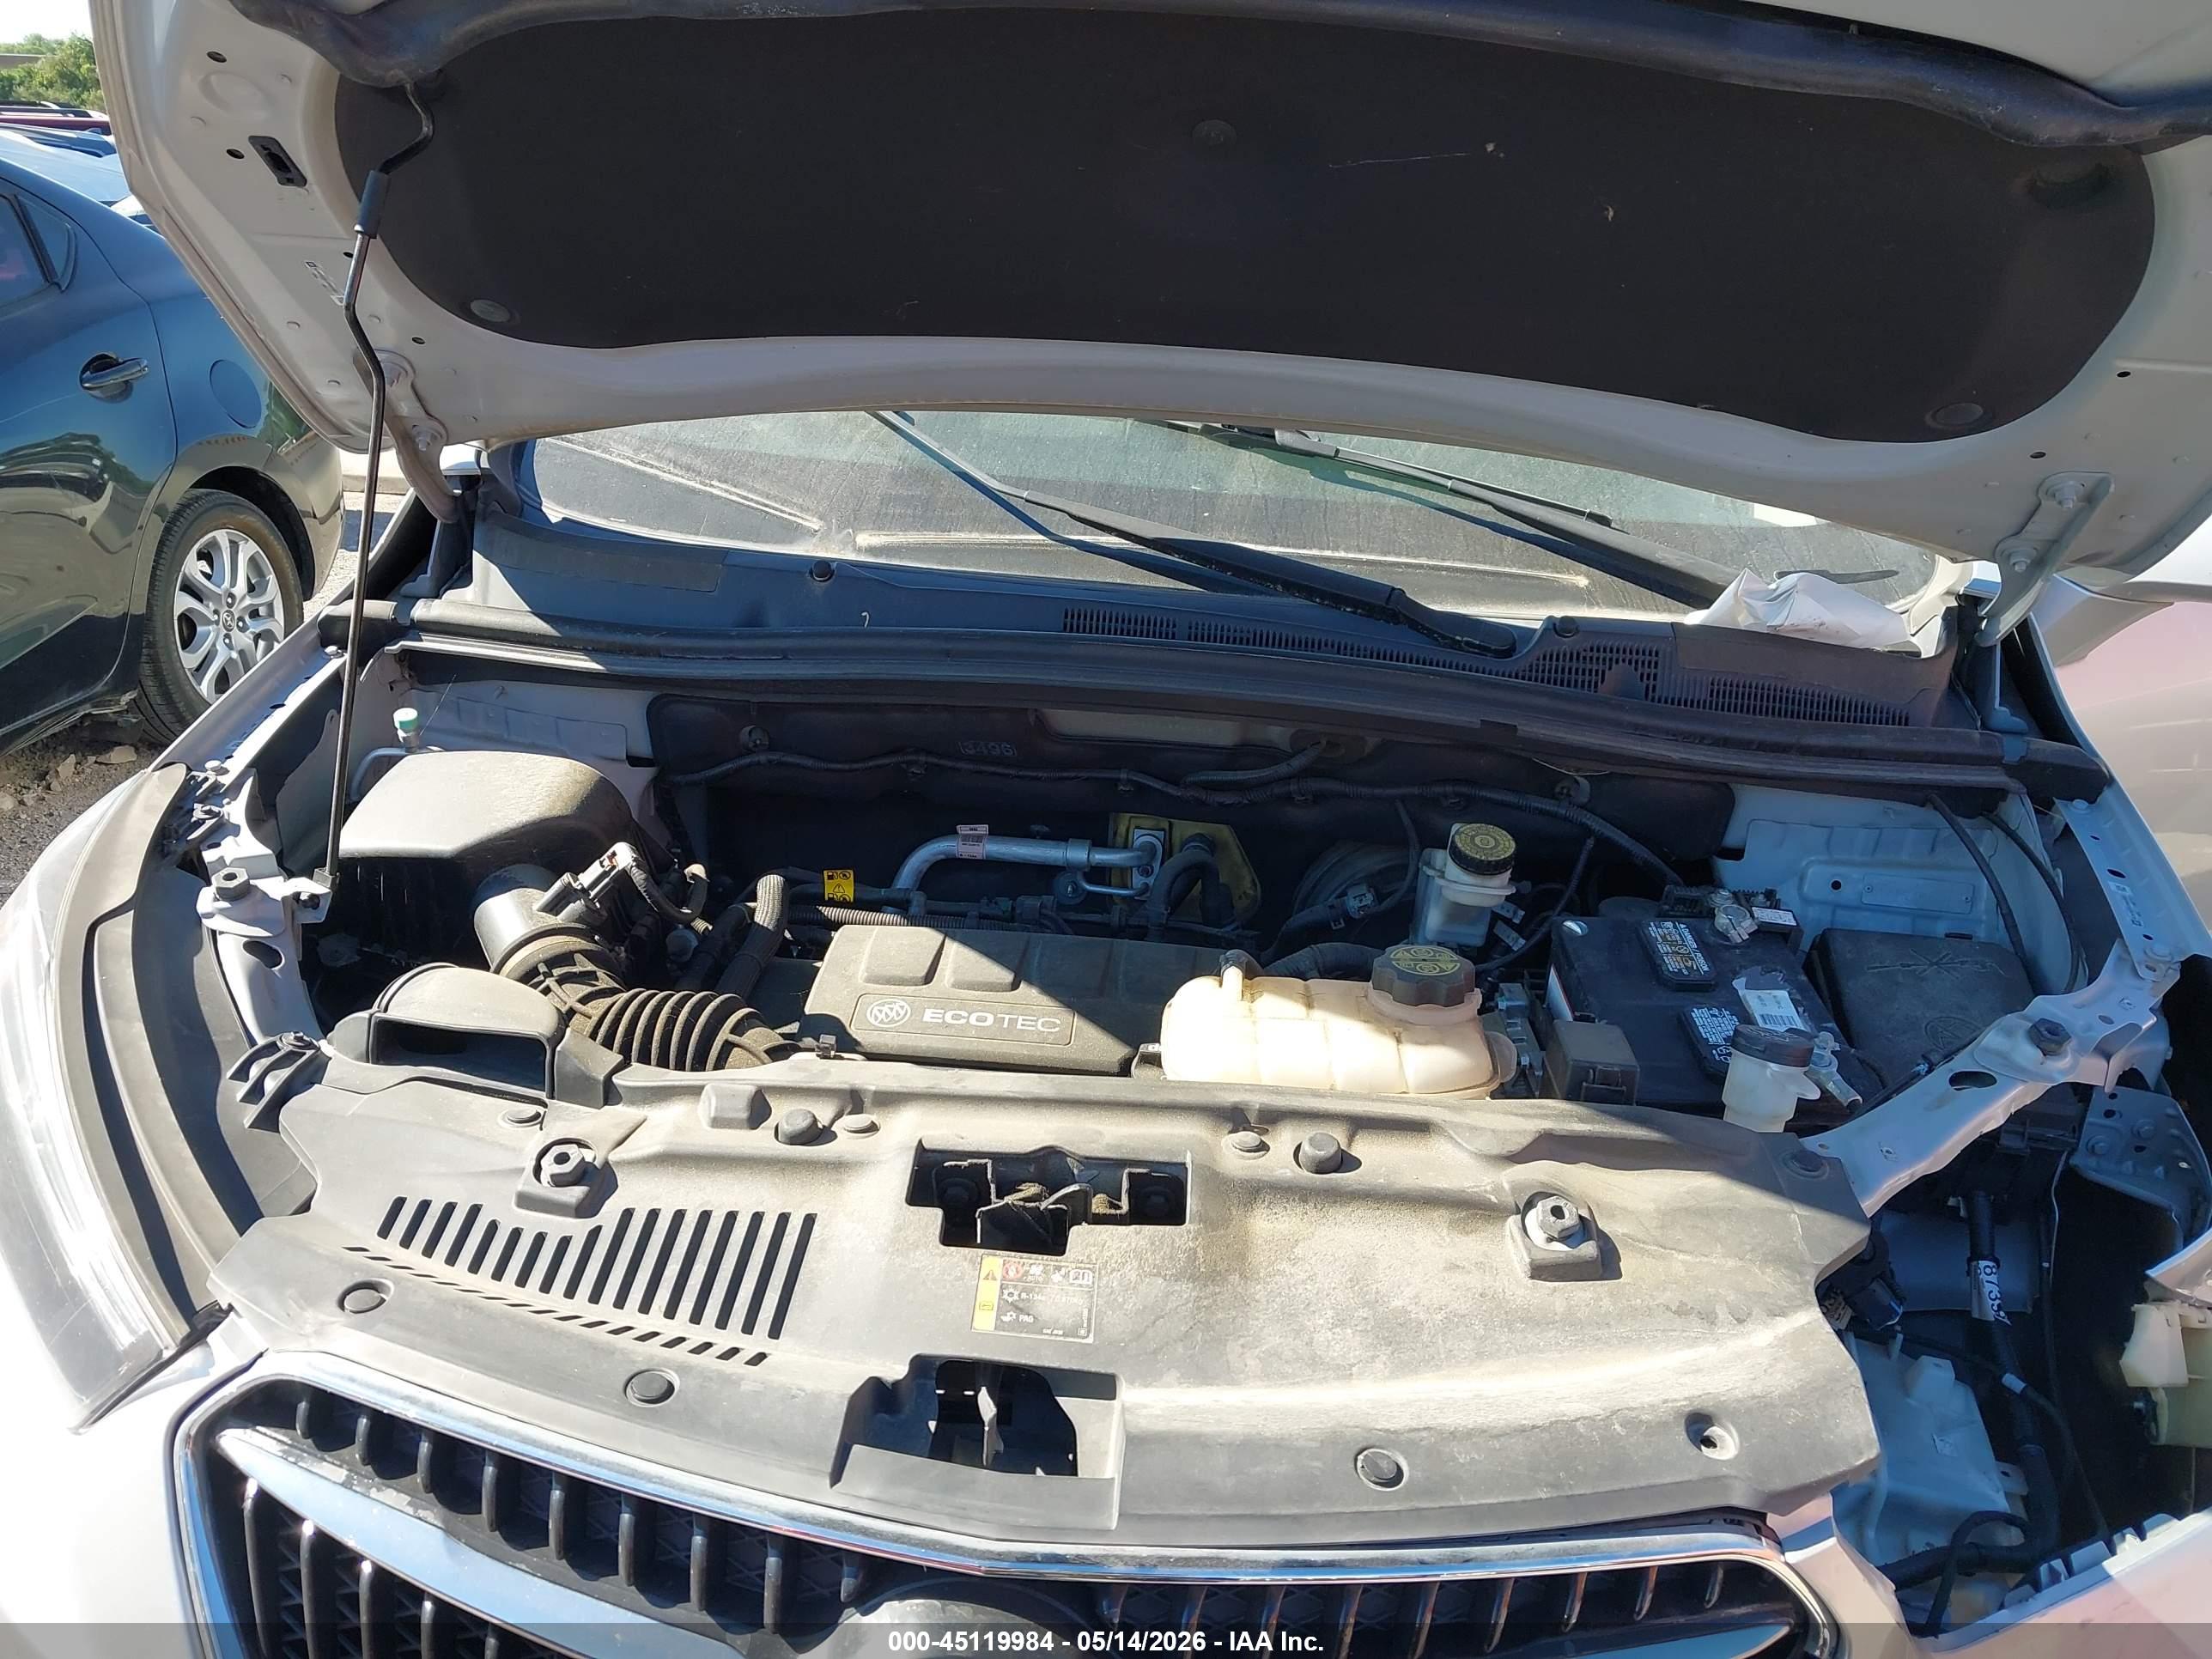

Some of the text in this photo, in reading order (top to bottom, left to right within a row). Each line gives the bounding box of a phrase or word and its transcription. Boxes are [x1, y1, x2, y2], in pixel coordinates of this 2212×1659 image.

[1682, 927, 1698, 949] DANGER
[1695, 952, 1711, 971] POISON
[922, 1008, 1060, 1032] ECOTEC
[1018, 1314, 1034, 1323] PAG
